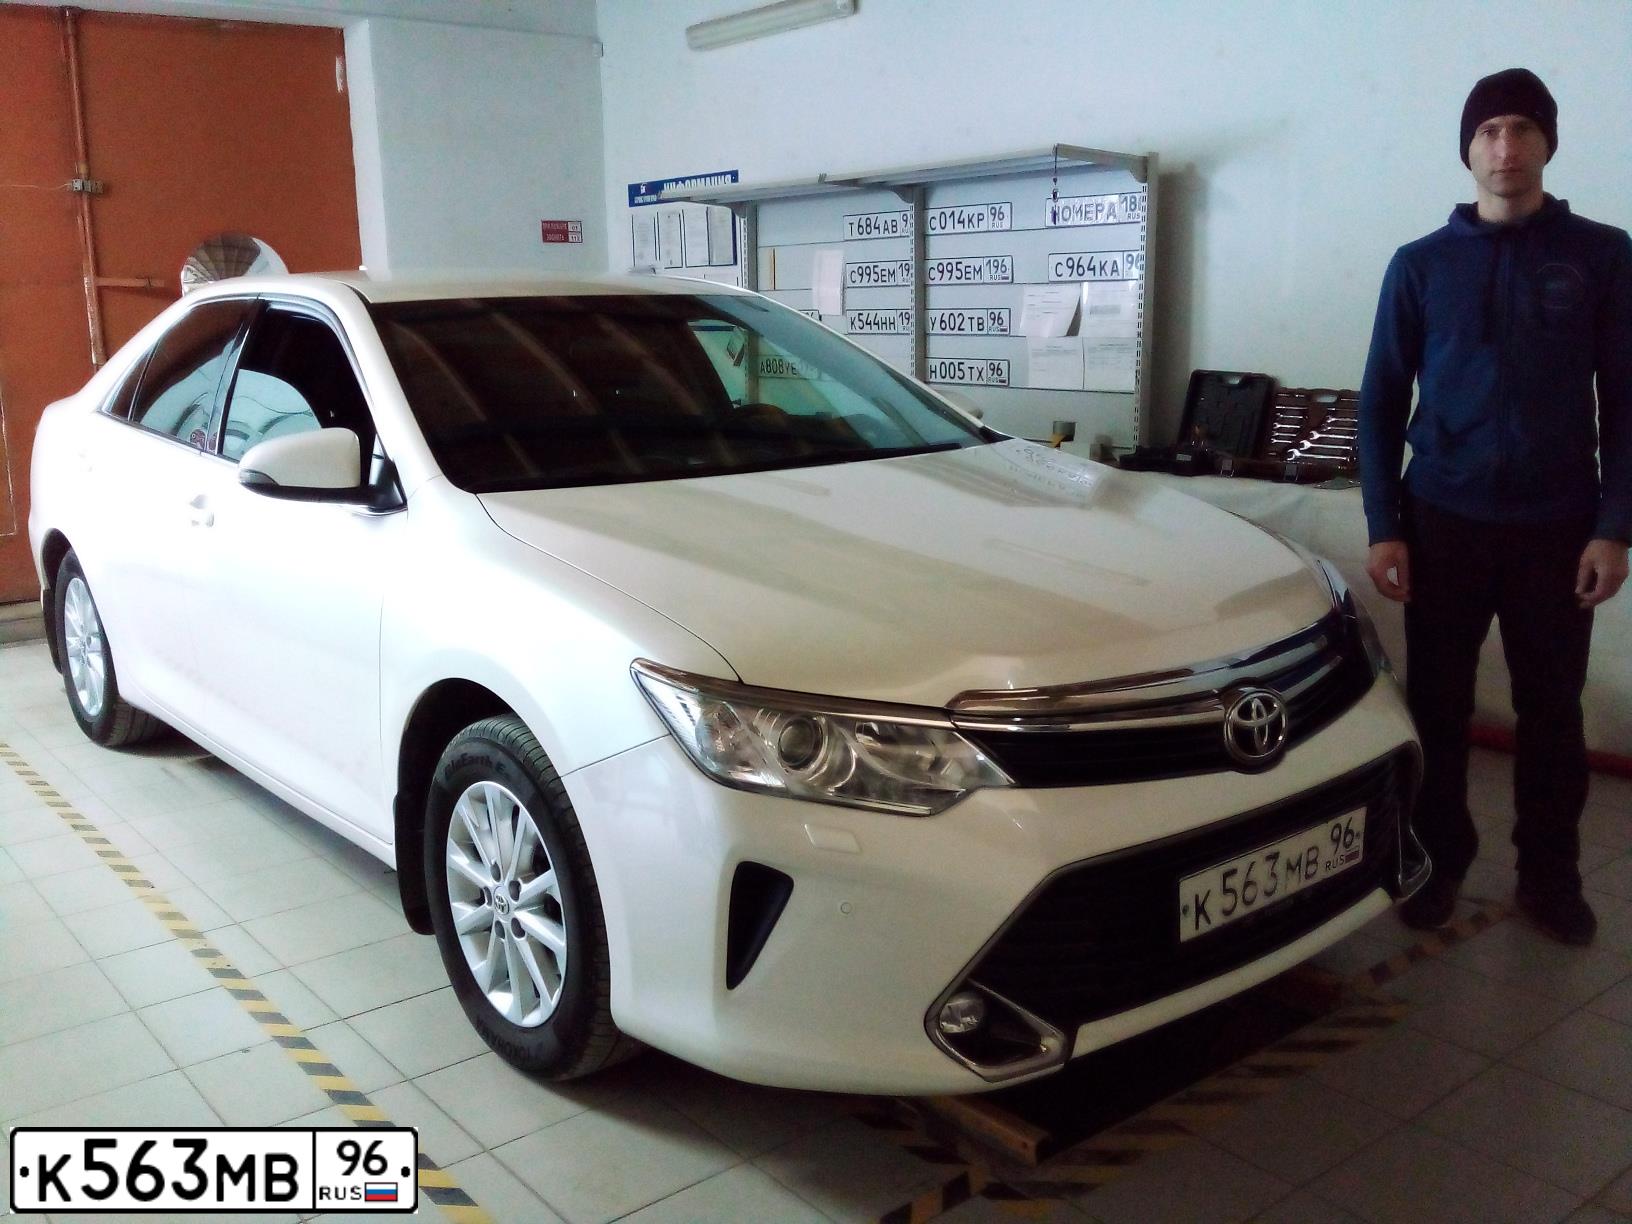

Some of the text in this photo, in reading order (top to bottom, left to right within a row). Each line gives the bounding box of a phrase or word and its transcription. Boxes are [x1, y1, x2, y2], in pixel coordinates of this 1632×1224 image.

[849, 216, 898, 236] Т684АВ
[929, 206, 1005, 230] С014КР 96
[850, 264, 896, 283] С995ЕМ
[928, 258, 1008, 281] С995ЕМ 196
[1055, 256, 1120, 277] С964КА
[850, 312, 896, 331] К544НН
[929, 311, 1004, 332] У602ТВ 96
[929, 361, 1003, 382] Н005ТХ 96
[1194, 817, 1355, 930] К563МВ 96
[1325, 855, 1345, 871] RUS
